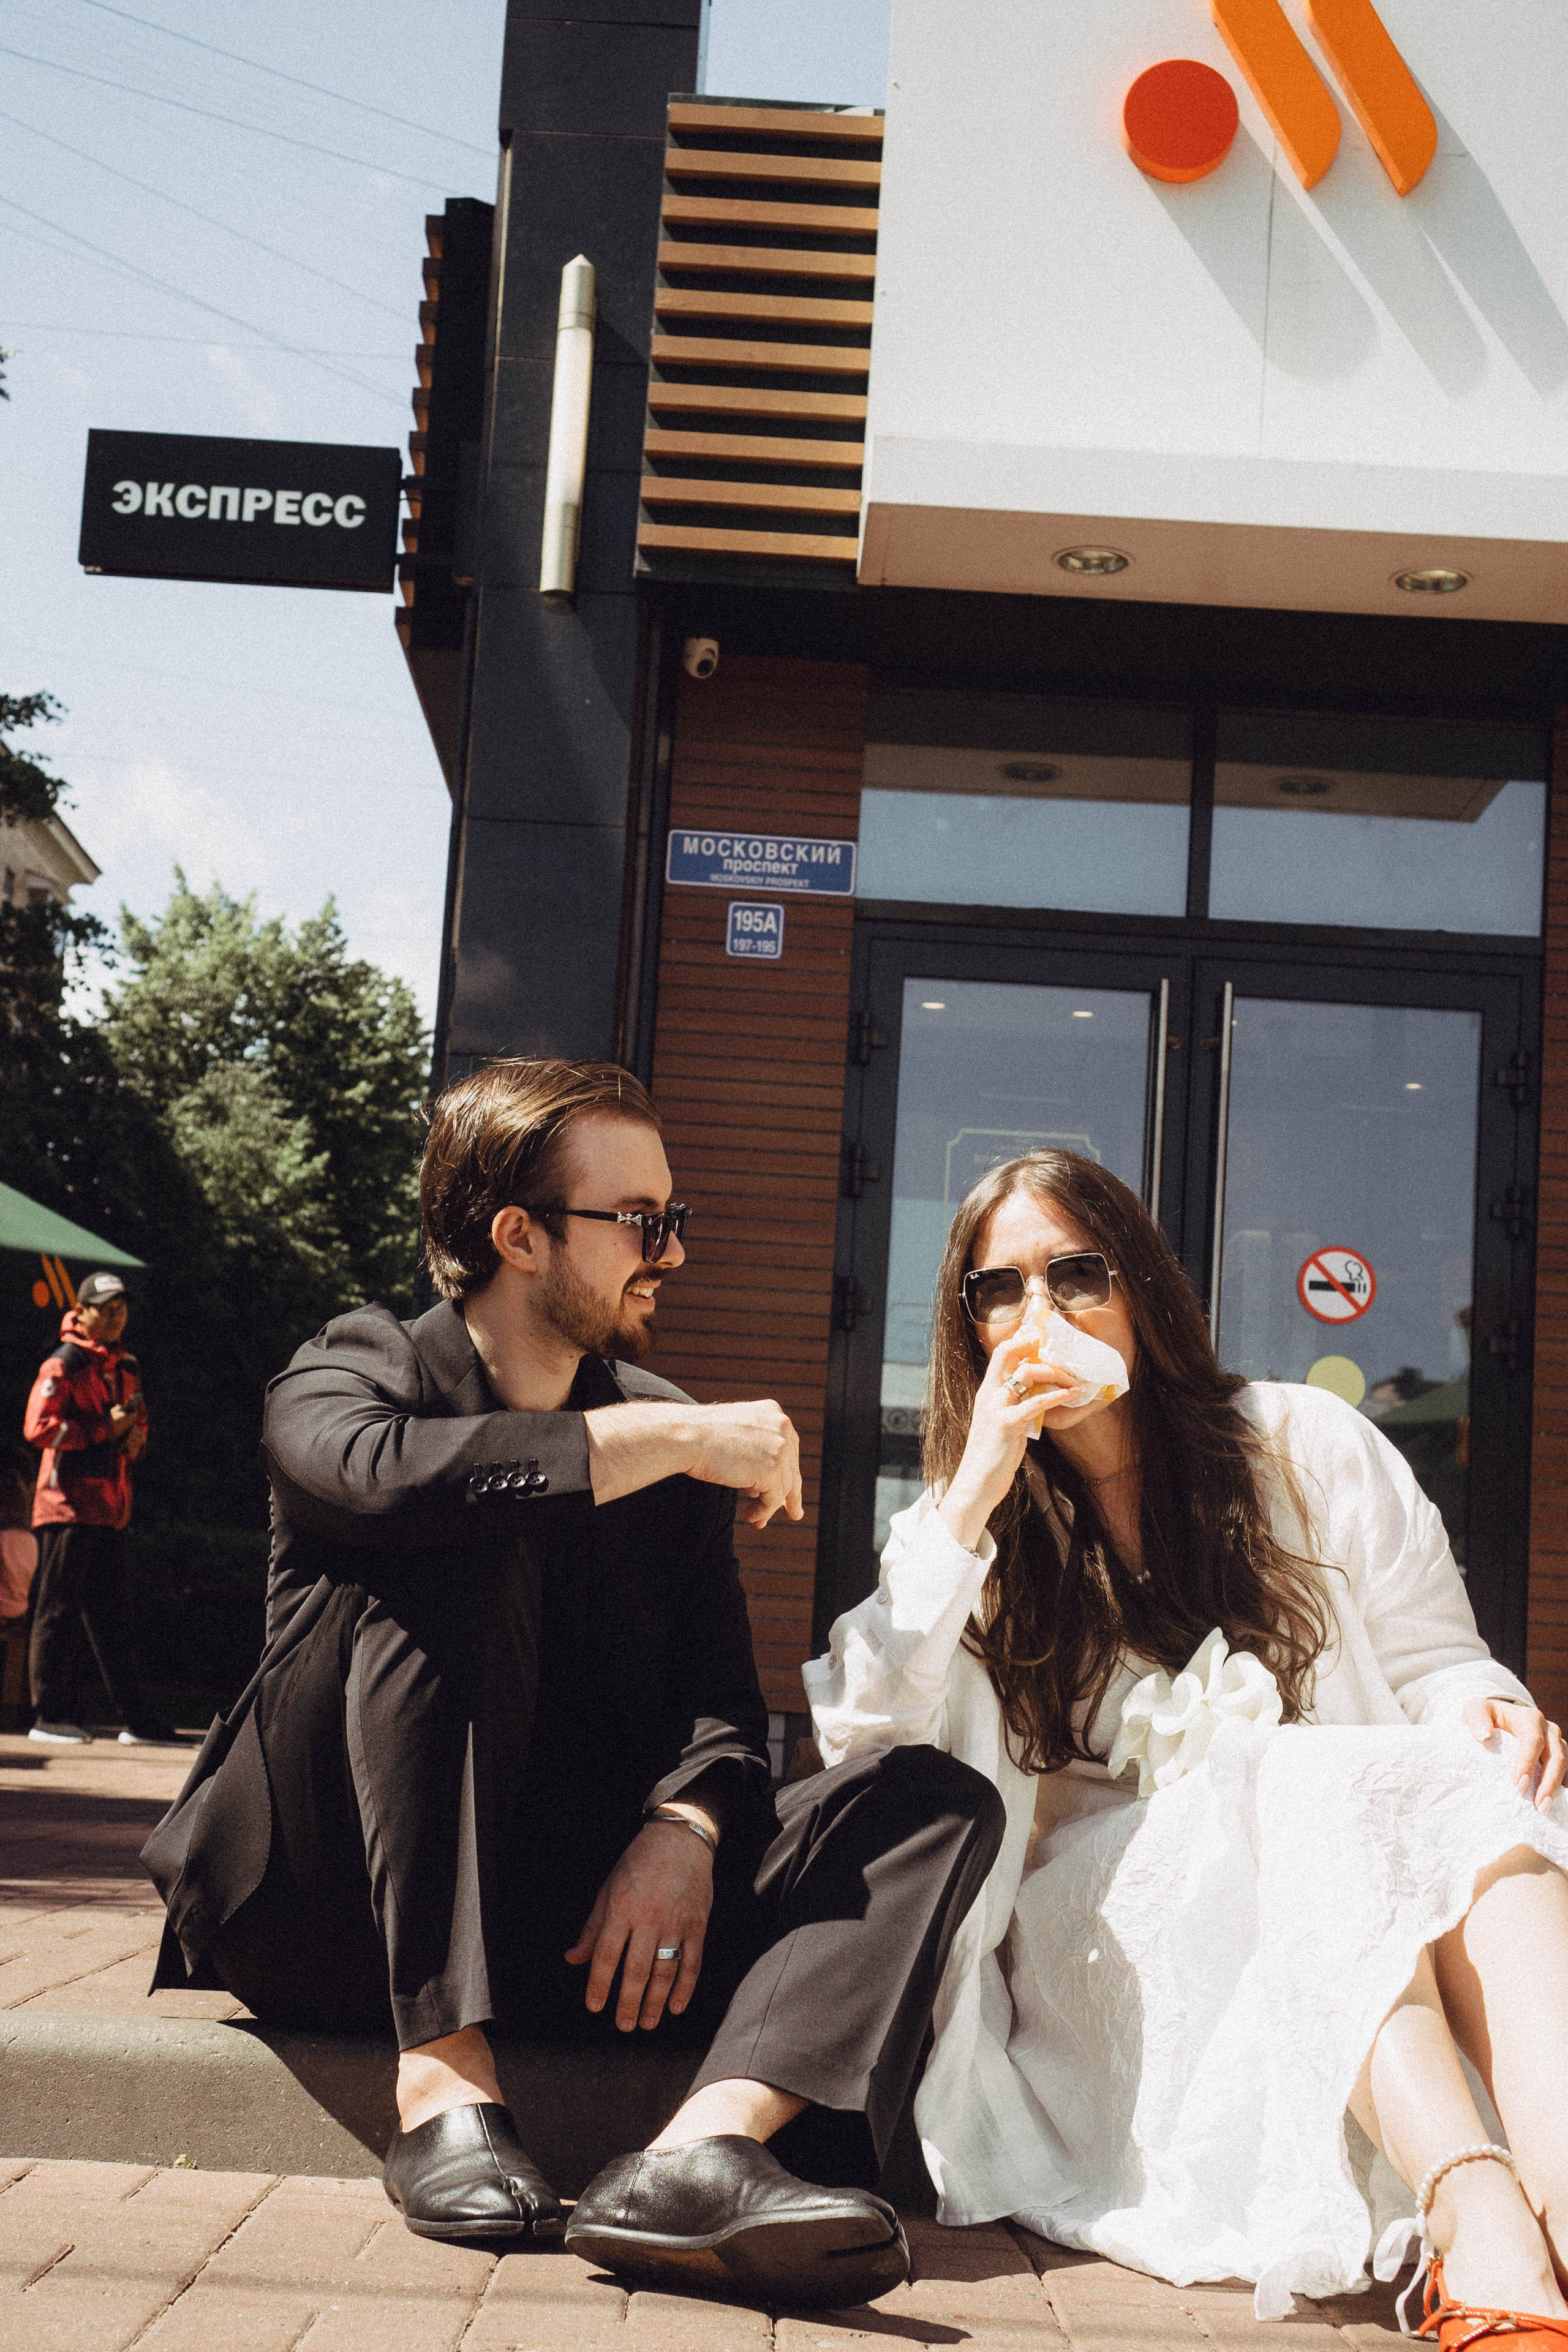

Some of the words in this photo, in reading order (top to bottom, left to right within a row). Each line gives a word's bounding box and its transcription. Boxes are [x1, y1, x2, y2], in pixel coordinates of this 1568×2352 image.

[111, 480, 366, 528] ЭКСПРЕСС
[683, 837, 841, 865] МОСКОВСКИЙ
[723, 858, 798, 875] проспект
[734, 910, 777, 933] 195А
